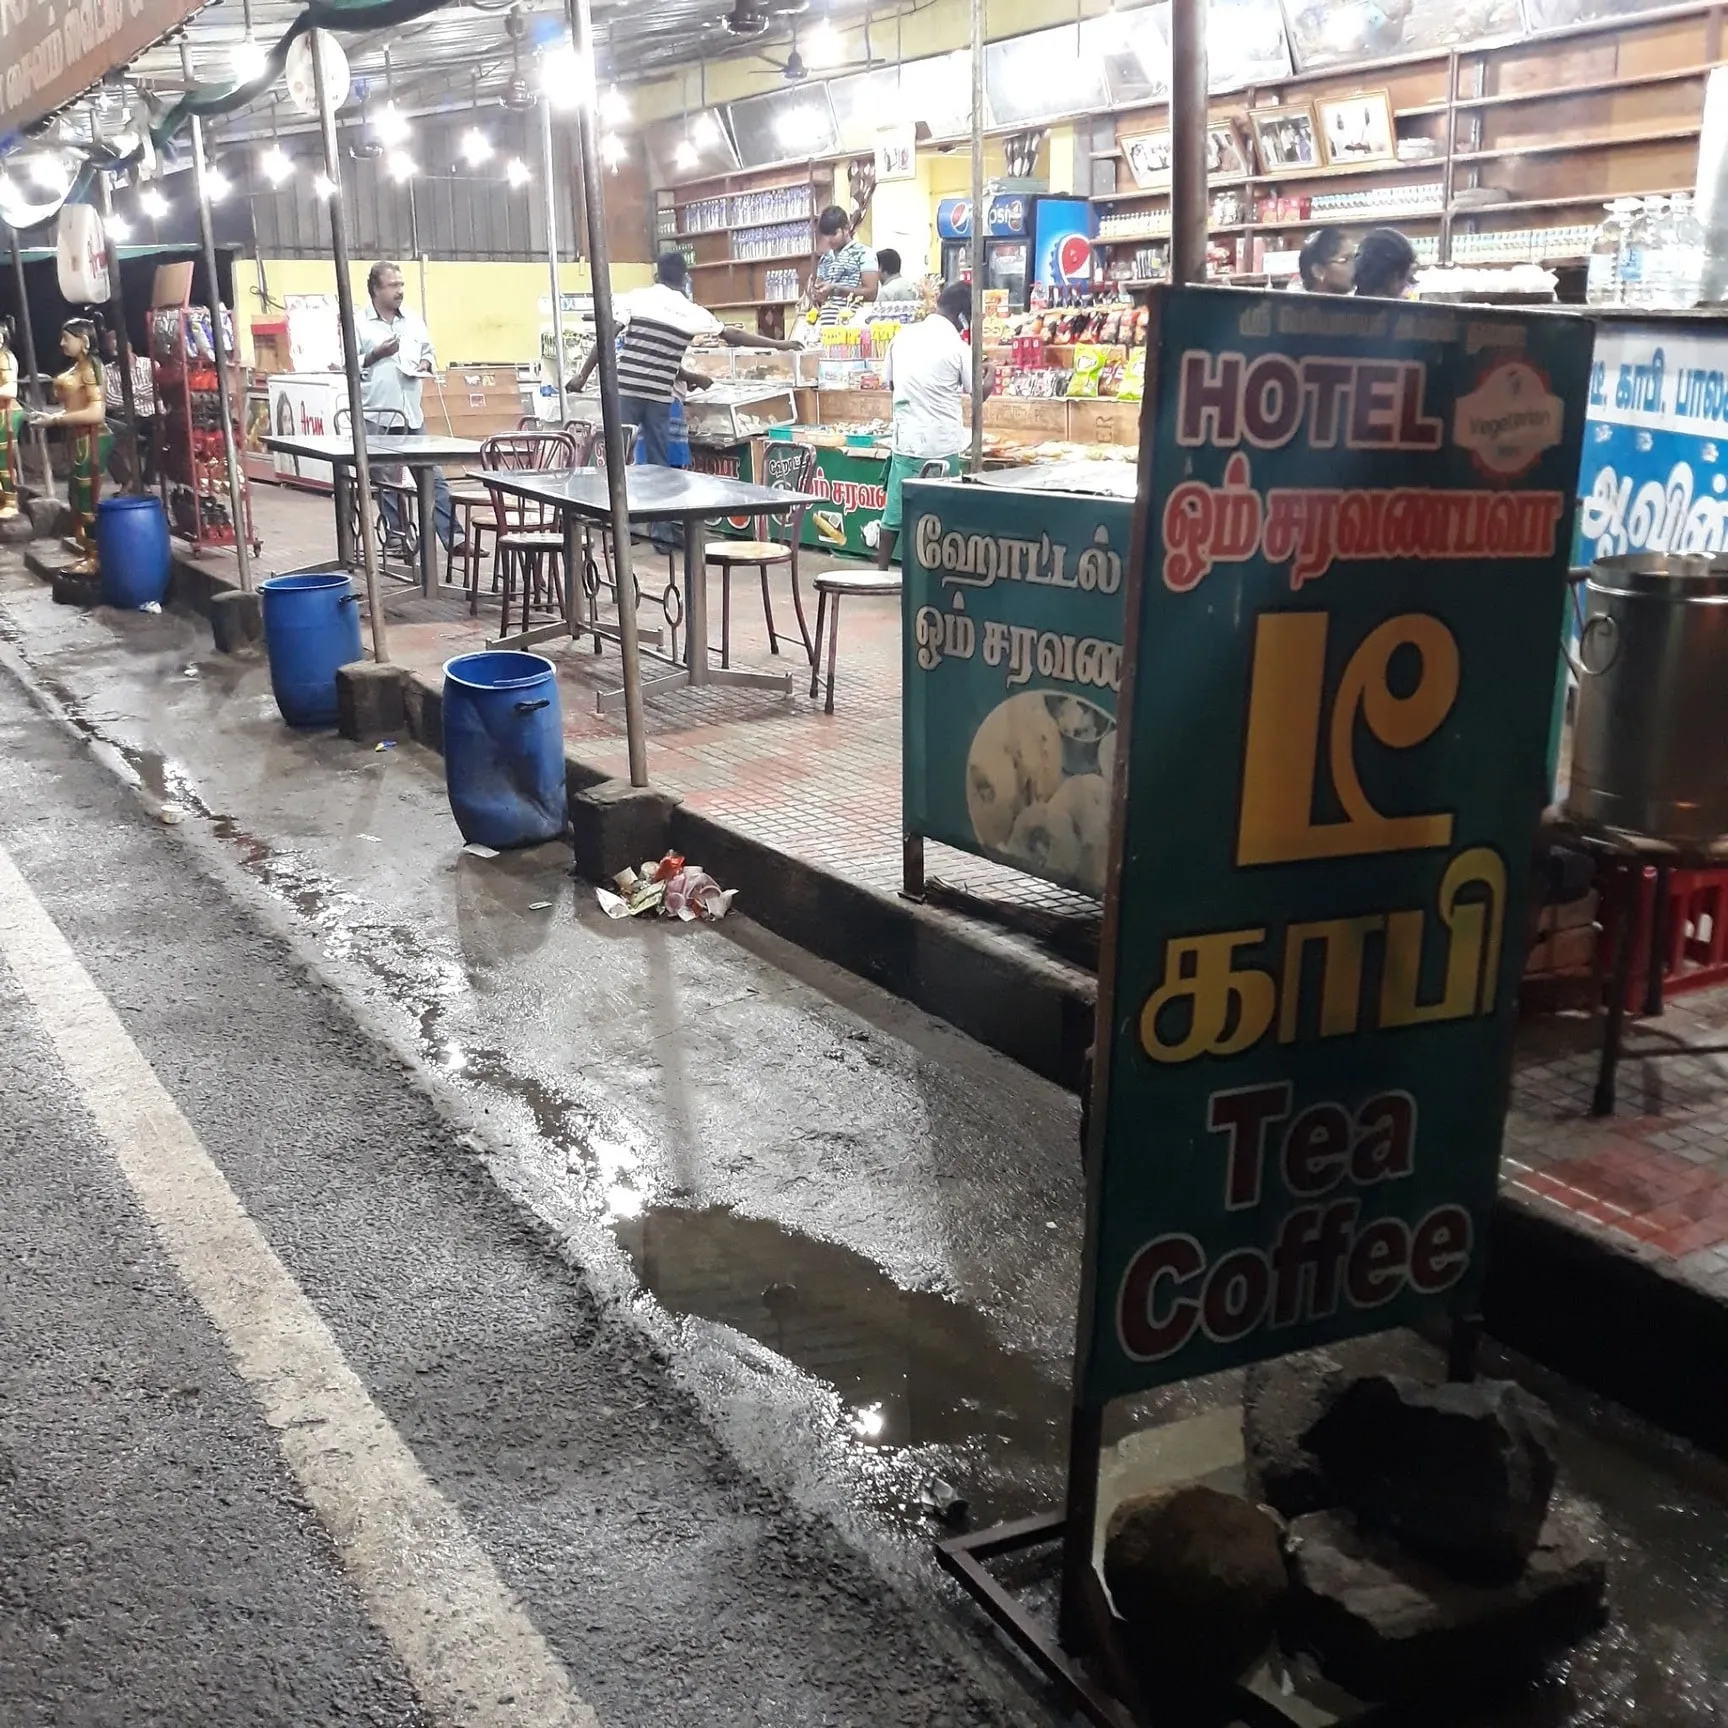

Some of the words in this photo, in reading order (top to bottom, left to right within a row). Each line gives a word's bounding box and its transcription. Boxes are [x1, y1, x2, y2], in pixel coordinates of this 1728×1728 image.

[1176, 350, 1443, 450] HOTEL
[916, 513, 1122, 594] ஹோட்டல்
[1163, 451, 1262, 592] ஓம்
[1262, 487, 1563, 591] சரவணபவா
[916, 591, 975, 671] ஓம்
[1236, 612, 1460, 867] டீ
[1140, 847, 1507, 1064] காபி
[1207, 1079, 1418, 1211] Tea
[1115, 1197, 1474, 1363] Coffee
